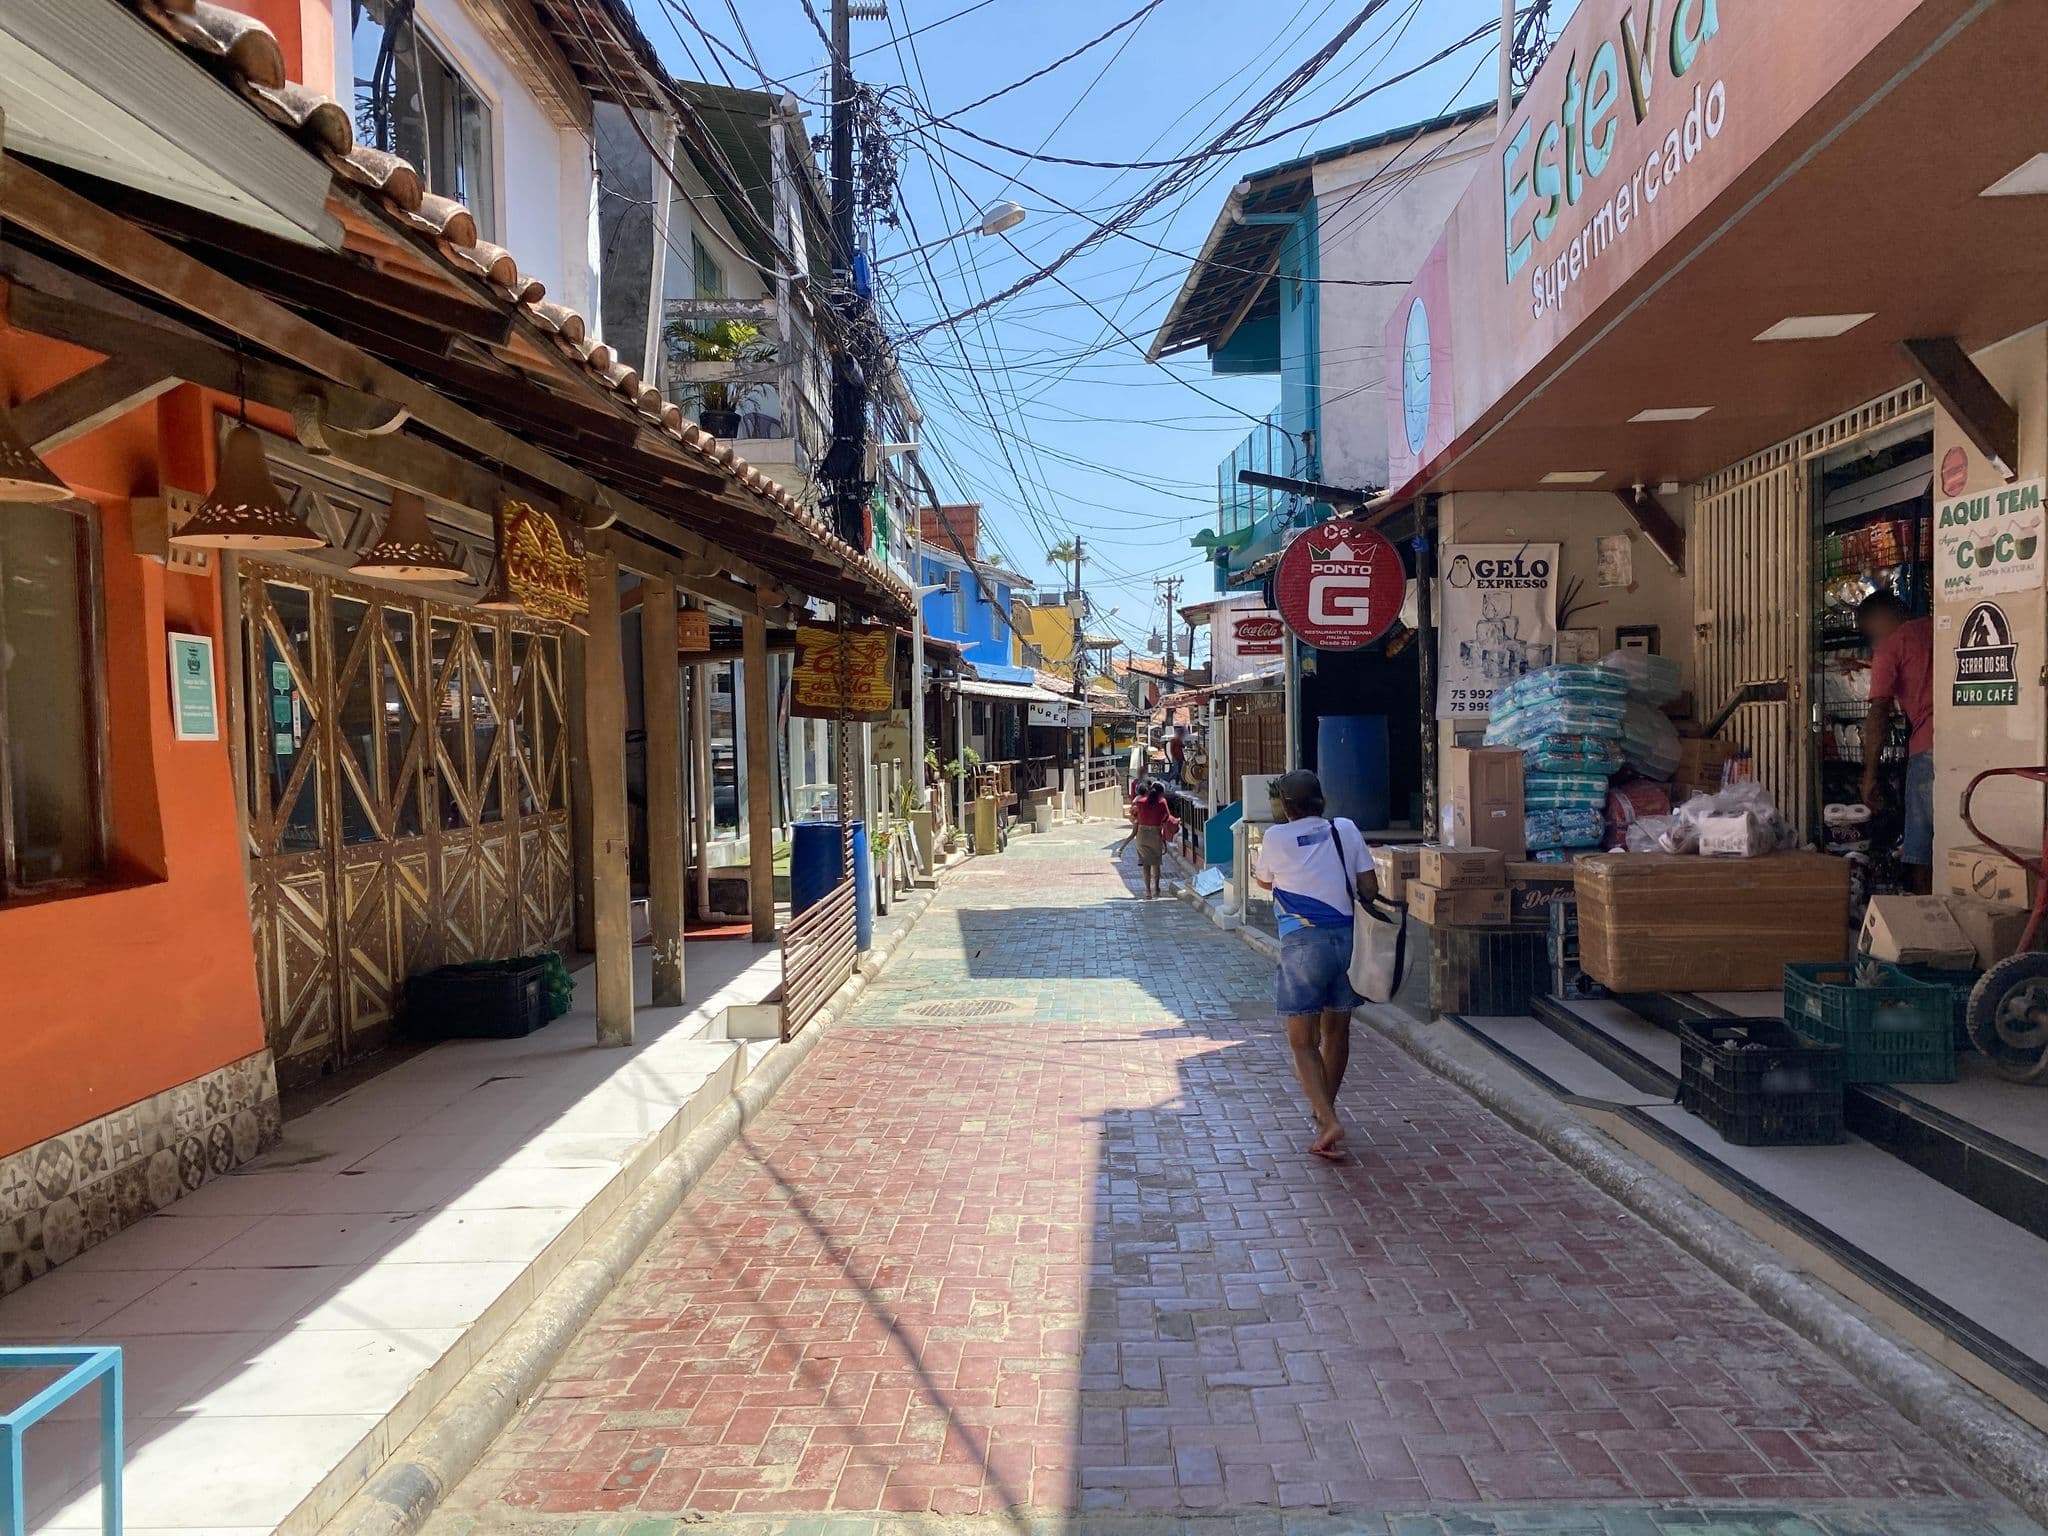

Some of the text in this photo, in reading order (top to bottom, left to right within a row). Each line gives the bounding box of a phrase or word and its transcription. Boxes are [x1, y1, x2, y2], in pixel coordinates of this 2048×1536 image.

[1532, 79, 1726, 320] Supermercado
[1939, 485, 2039, 529] AQUI TEM
[1311, 564, 1372, 575] PONTO
[1475, 559, 1550, 579] GELO
[1476, 579, 1548, 589] EXPRESSO
[1308, 575, 1371, 626] G
[1238, 622, 1277, 637] Coca-Cola
[1451, 689, 1497, 700] 75 992
[1956, 685, 2014, 702] PURO CAFÉ
[1030, 704, 1067, 724] AUREA
[1450, 702, 1465, 711] 75
